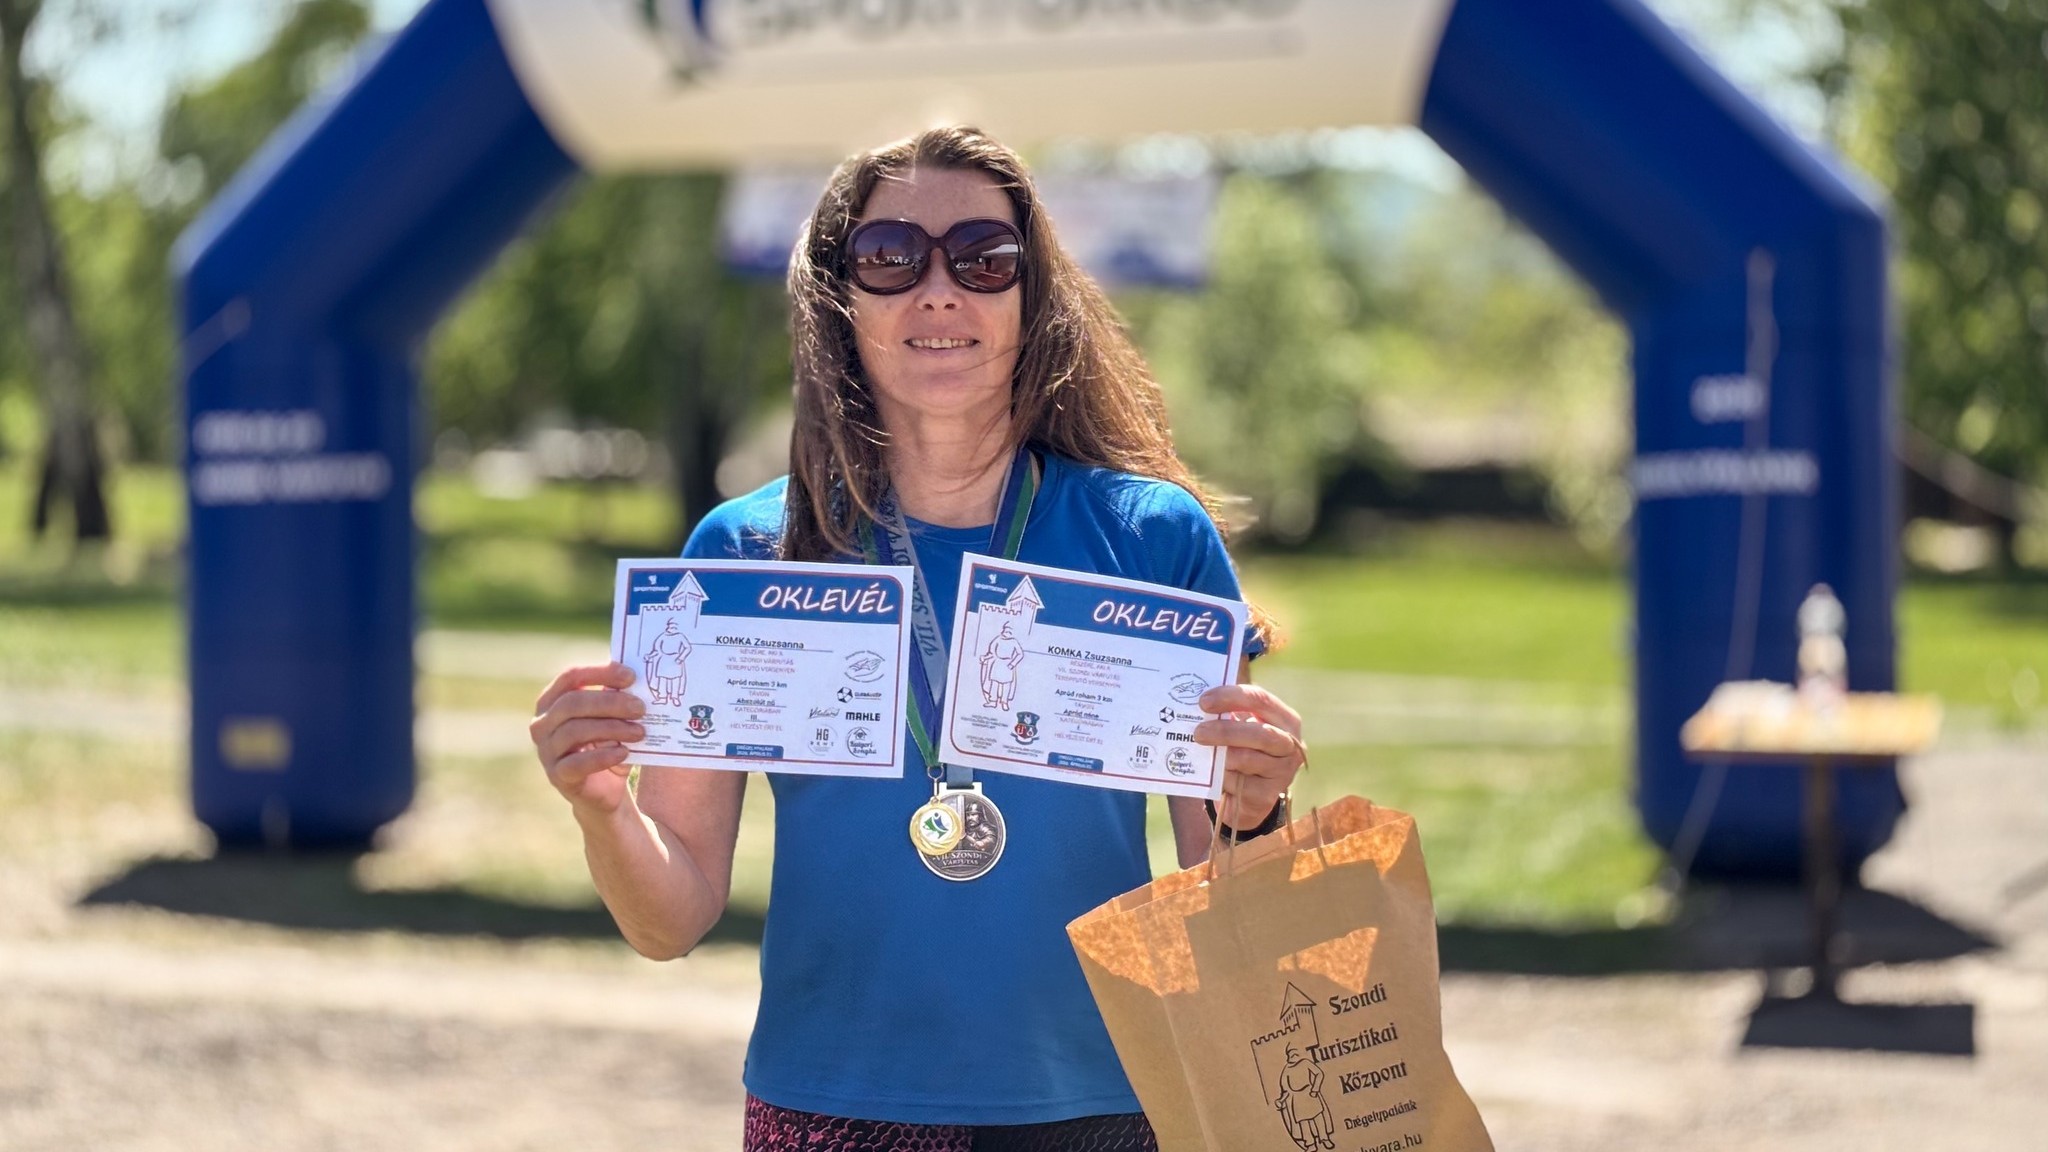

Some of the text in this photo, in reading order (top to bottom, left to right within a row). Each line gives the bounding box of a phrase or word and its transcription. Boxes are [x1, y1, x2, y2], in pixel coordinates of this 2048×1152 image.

[760, 582, 894, 613] OKLEVÉL
[1092, 600, 1225, 641] OKLEVÉL
[715, 635, 805, 649] KOMKA Zsuzsanna
[1047, 645, 1132, 666] KOMKA Zsuzsanna
[1075, 691, 1096, 700] roham
[1102, 695, 1113, 703] km
[845, 711, 881, 721] MAHLE
[816, 728, 829, 741] HG
[1166, 731, 1196, 743] MAHL
[1136, 745, 1150, 759] HG
[951, 852, 982, 860] SZONDI
[1328, 982, 1388, 1016] Szondi
[1305, 1022, 1399, 1064] Turisztikai
[1338, 1059, 1409, 1095] Központ
[1343, 1099, 1418, 1130] Drégelypalánk
